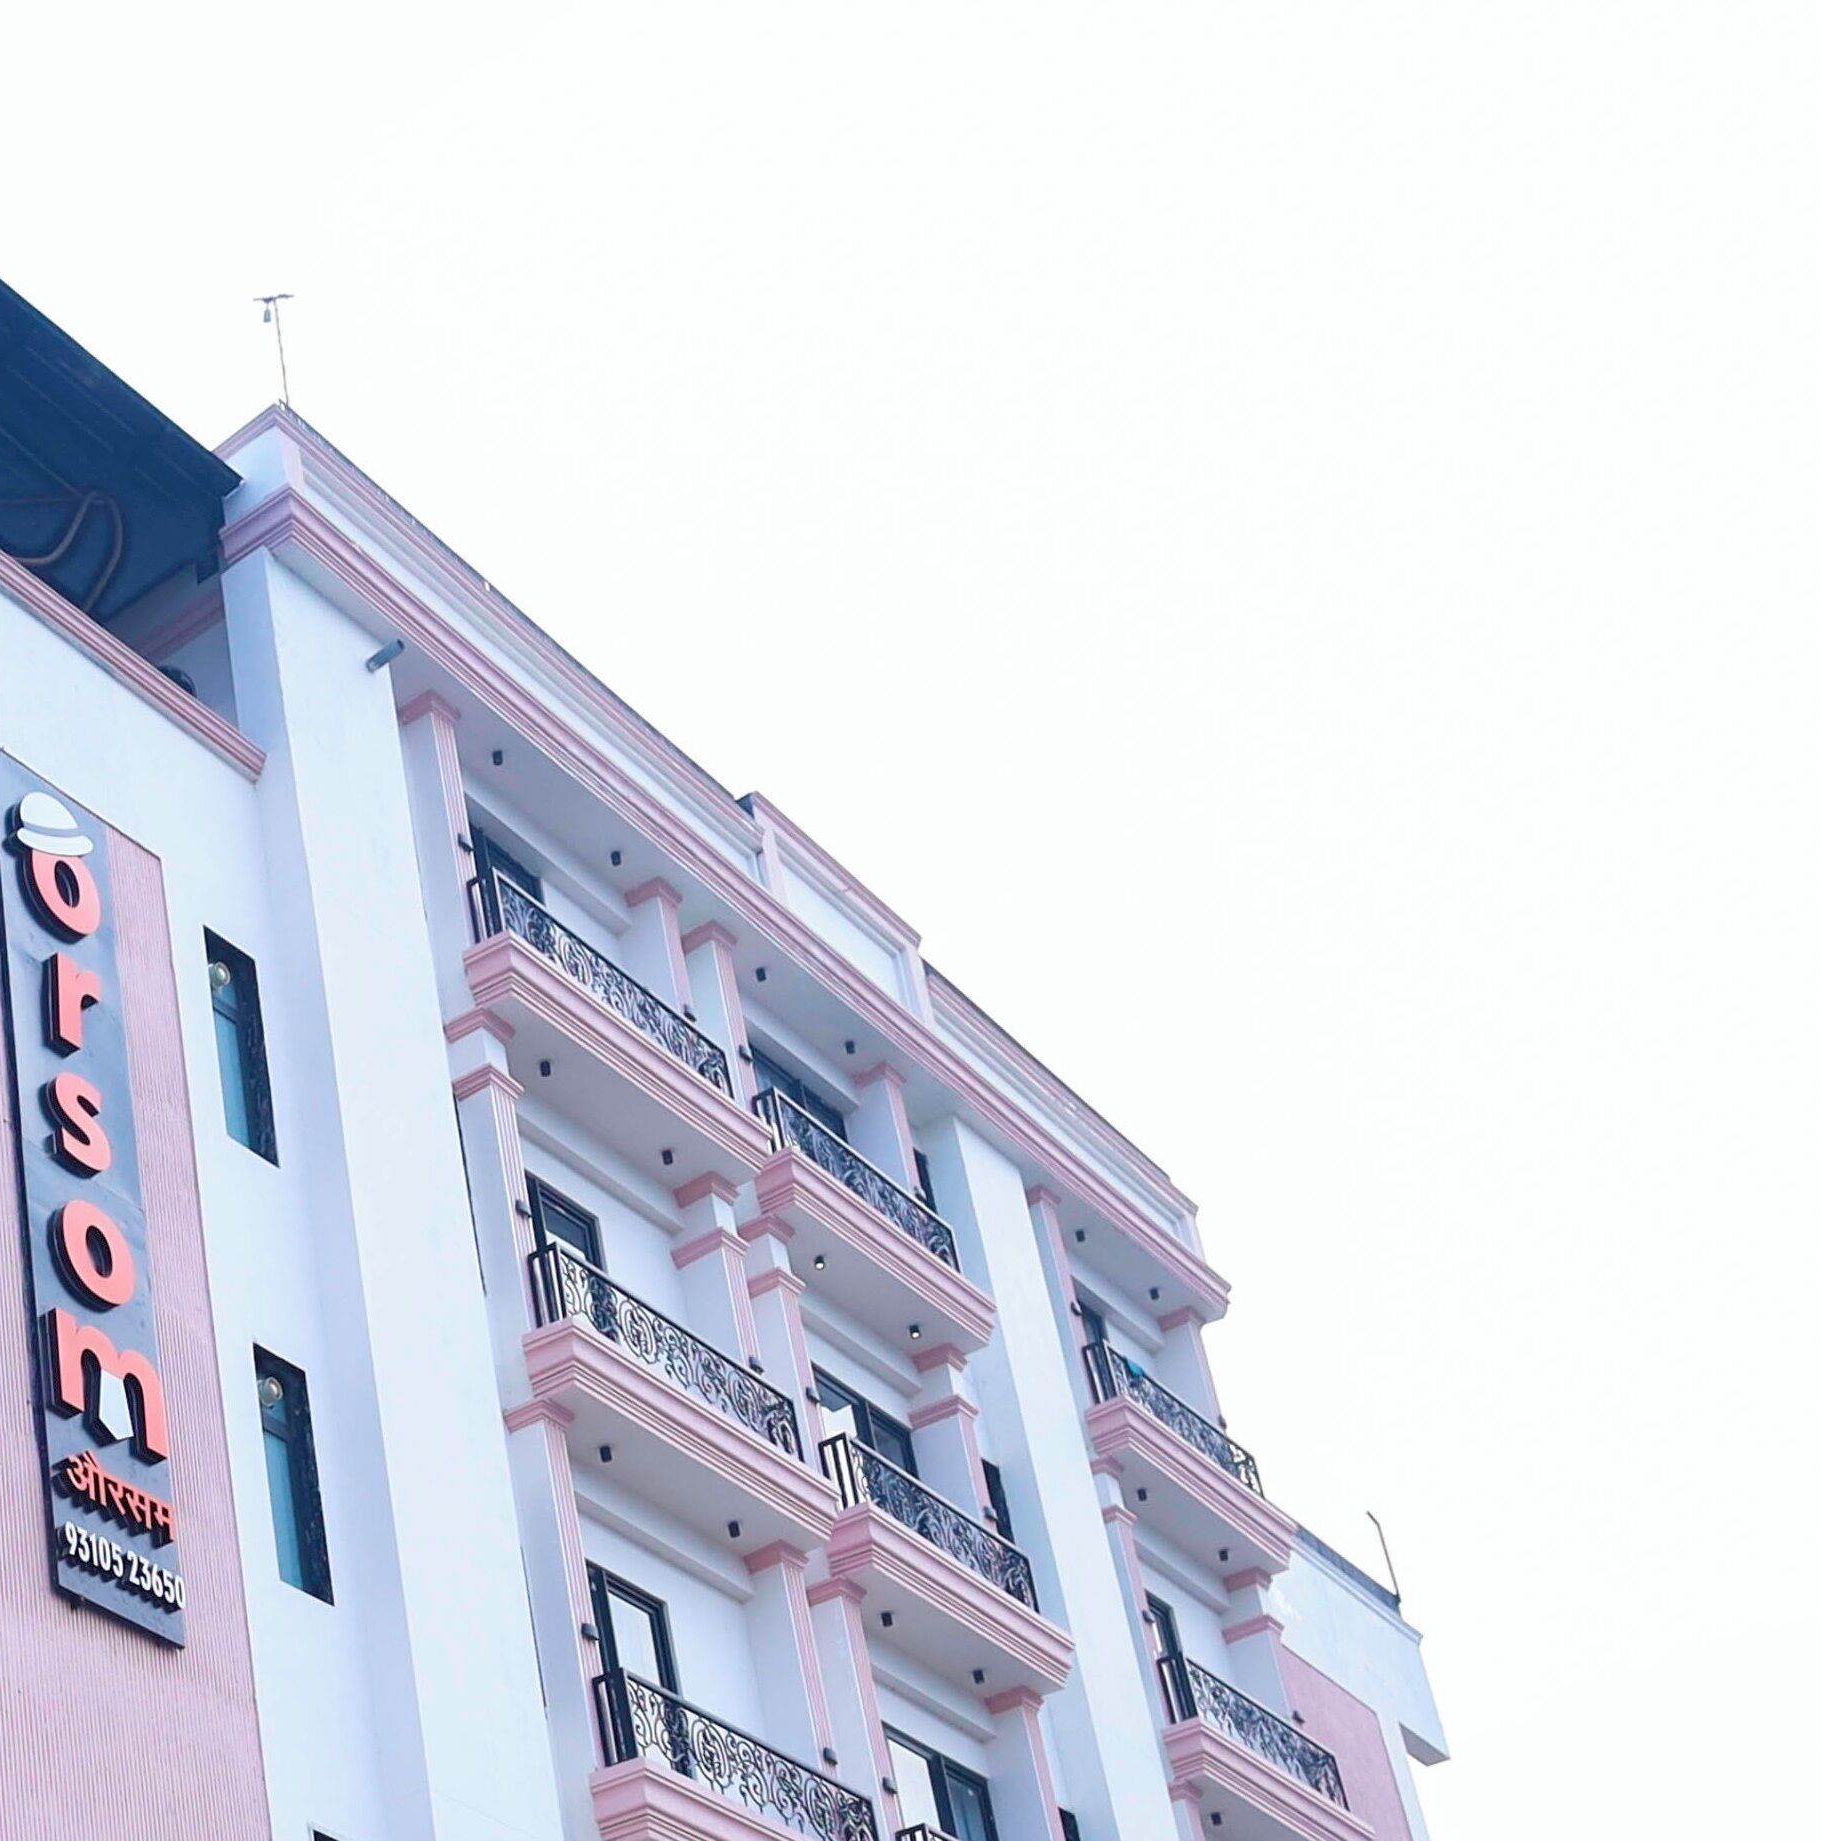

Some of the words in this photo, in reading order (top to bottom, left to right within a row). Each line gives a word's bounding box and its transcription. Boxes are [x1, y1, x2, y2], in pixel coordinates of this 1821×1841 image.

[30, 846, 168, 1460] orsom
[65, 1521, 124, 1578] 93105
[126, 1551, 186, 1609] 23650
